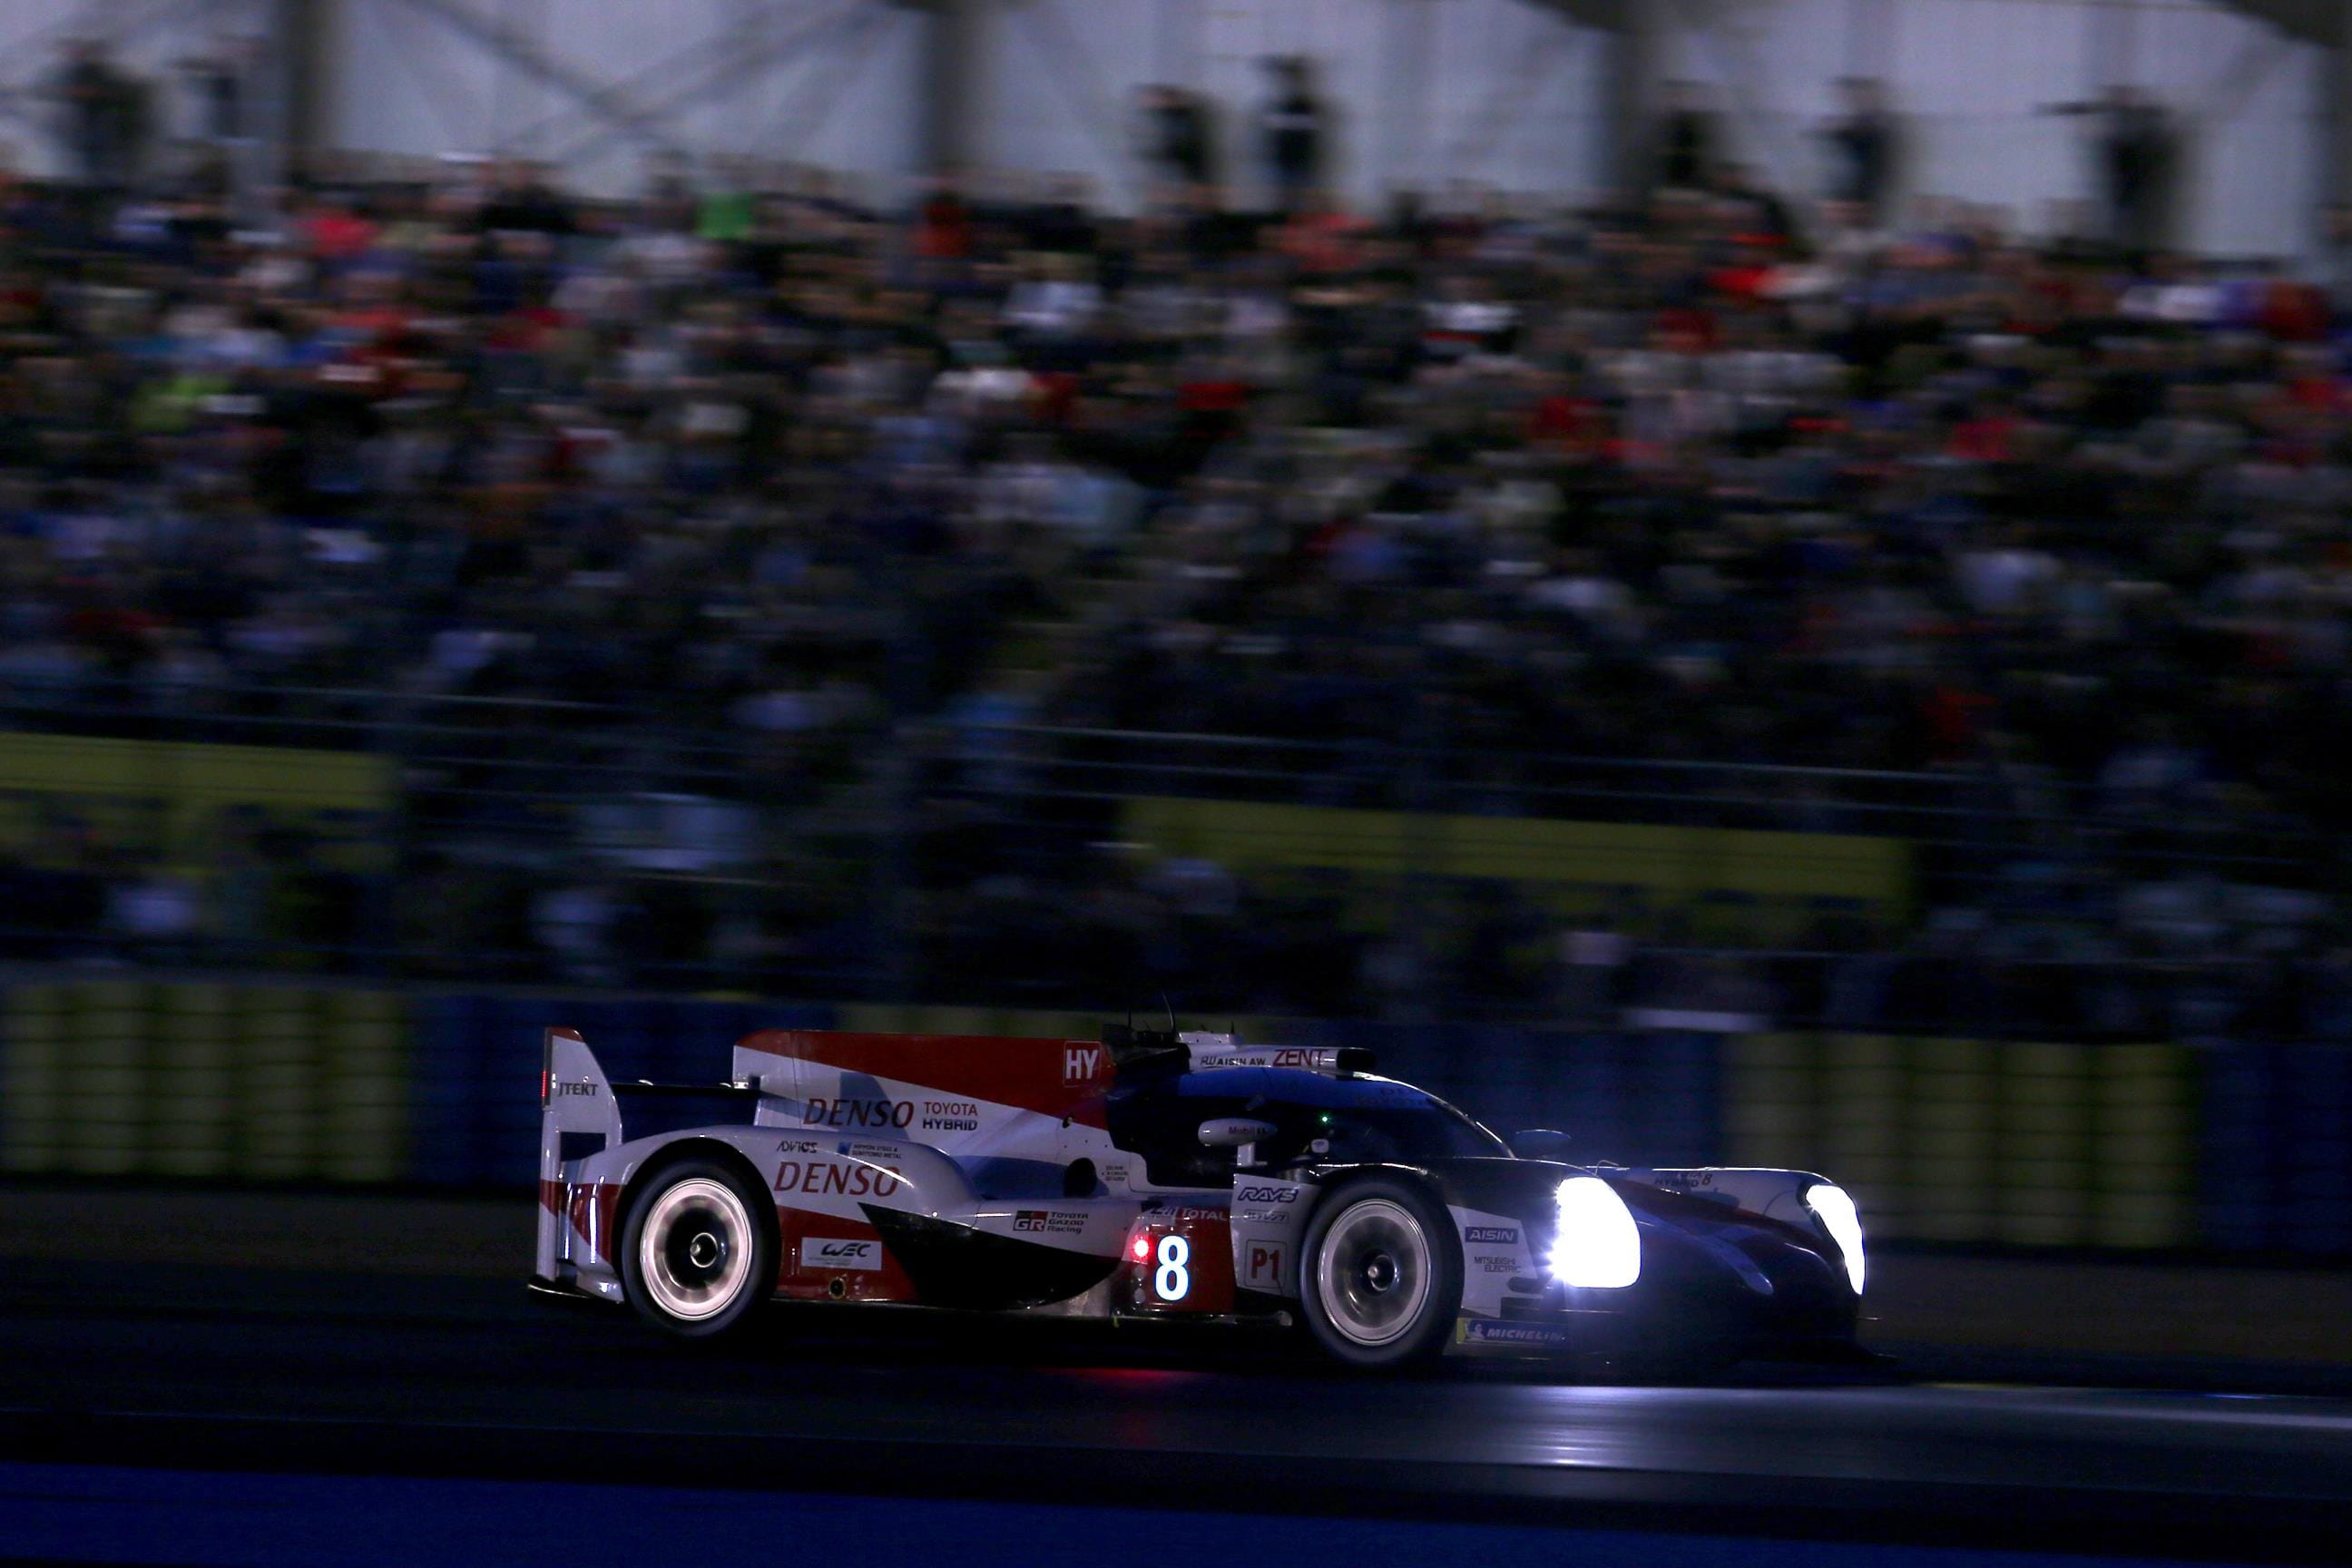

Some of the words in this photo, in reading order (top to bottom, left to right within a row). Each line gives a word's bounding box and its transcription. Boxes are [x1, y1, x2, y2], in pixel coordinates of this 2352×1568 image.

[1250, 1057, 1266, 1065] AW
[1273, 1048, 1329, 1067] ZENT
[1065, 1049, 1099, 1080] HY
[558, 1083, 598, 1096] JTEKT
[803, 1098, 915, 1128] DENSO
[923, 1102, 978, 1116] TOYOTA
[922, 1118, 978, 1131] HYBRID
[774, 1161, 901, 1197] DENSO
[1238, 1187, 1299, 1203] RAYS
[1051, 1211, 1089, 1220] TOYOTA
[1181, 1207, 1228, 1220] TOTAL
[1014, 1218, 1045, 1230] GR
[1047, 1225, 1082, 1234] Racing
[1469, 1229, 1514, 1241] AISIN
[821, 1242, 871, 1258] WEC
[1251, 1248, 1280, 1280] P1
[1474, 1256, 1516, 1265] MITSUBISHI
[1154, 1234, 1191, 1301] 8
[1484, 1264, 1523, 1272] ELECTRIC
